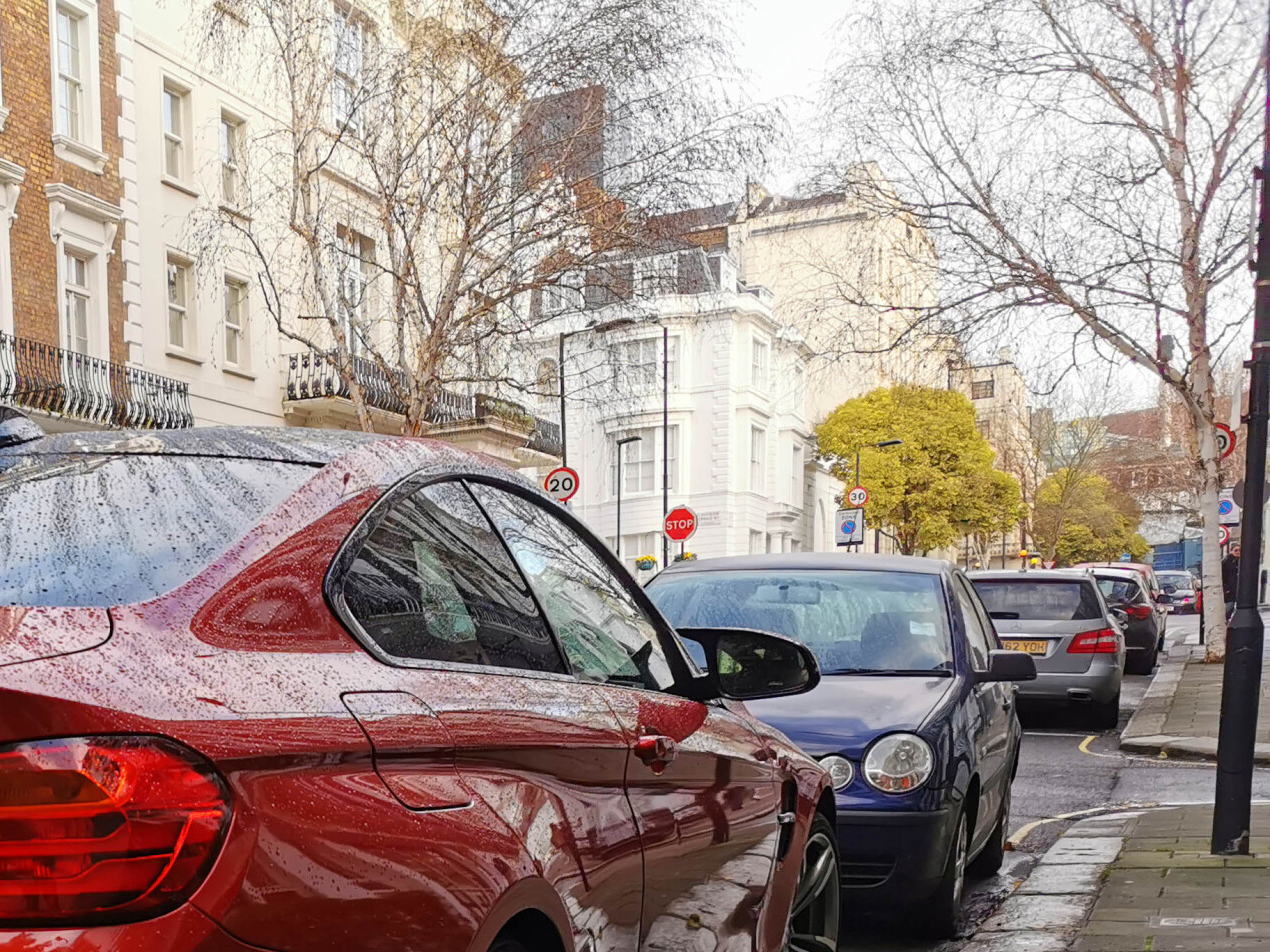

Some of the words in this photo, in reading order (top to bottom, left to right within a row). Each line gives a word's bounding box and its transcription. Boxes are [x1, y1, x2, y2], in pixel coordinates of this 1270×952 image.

[549, 477, 573, 492] 20
[850, 492, 866, 502] 30
[665, 518, 694, 531] STOP
[1001, 642, 1020, 652] 62
[1023, 642, 1045, 652] YOH
